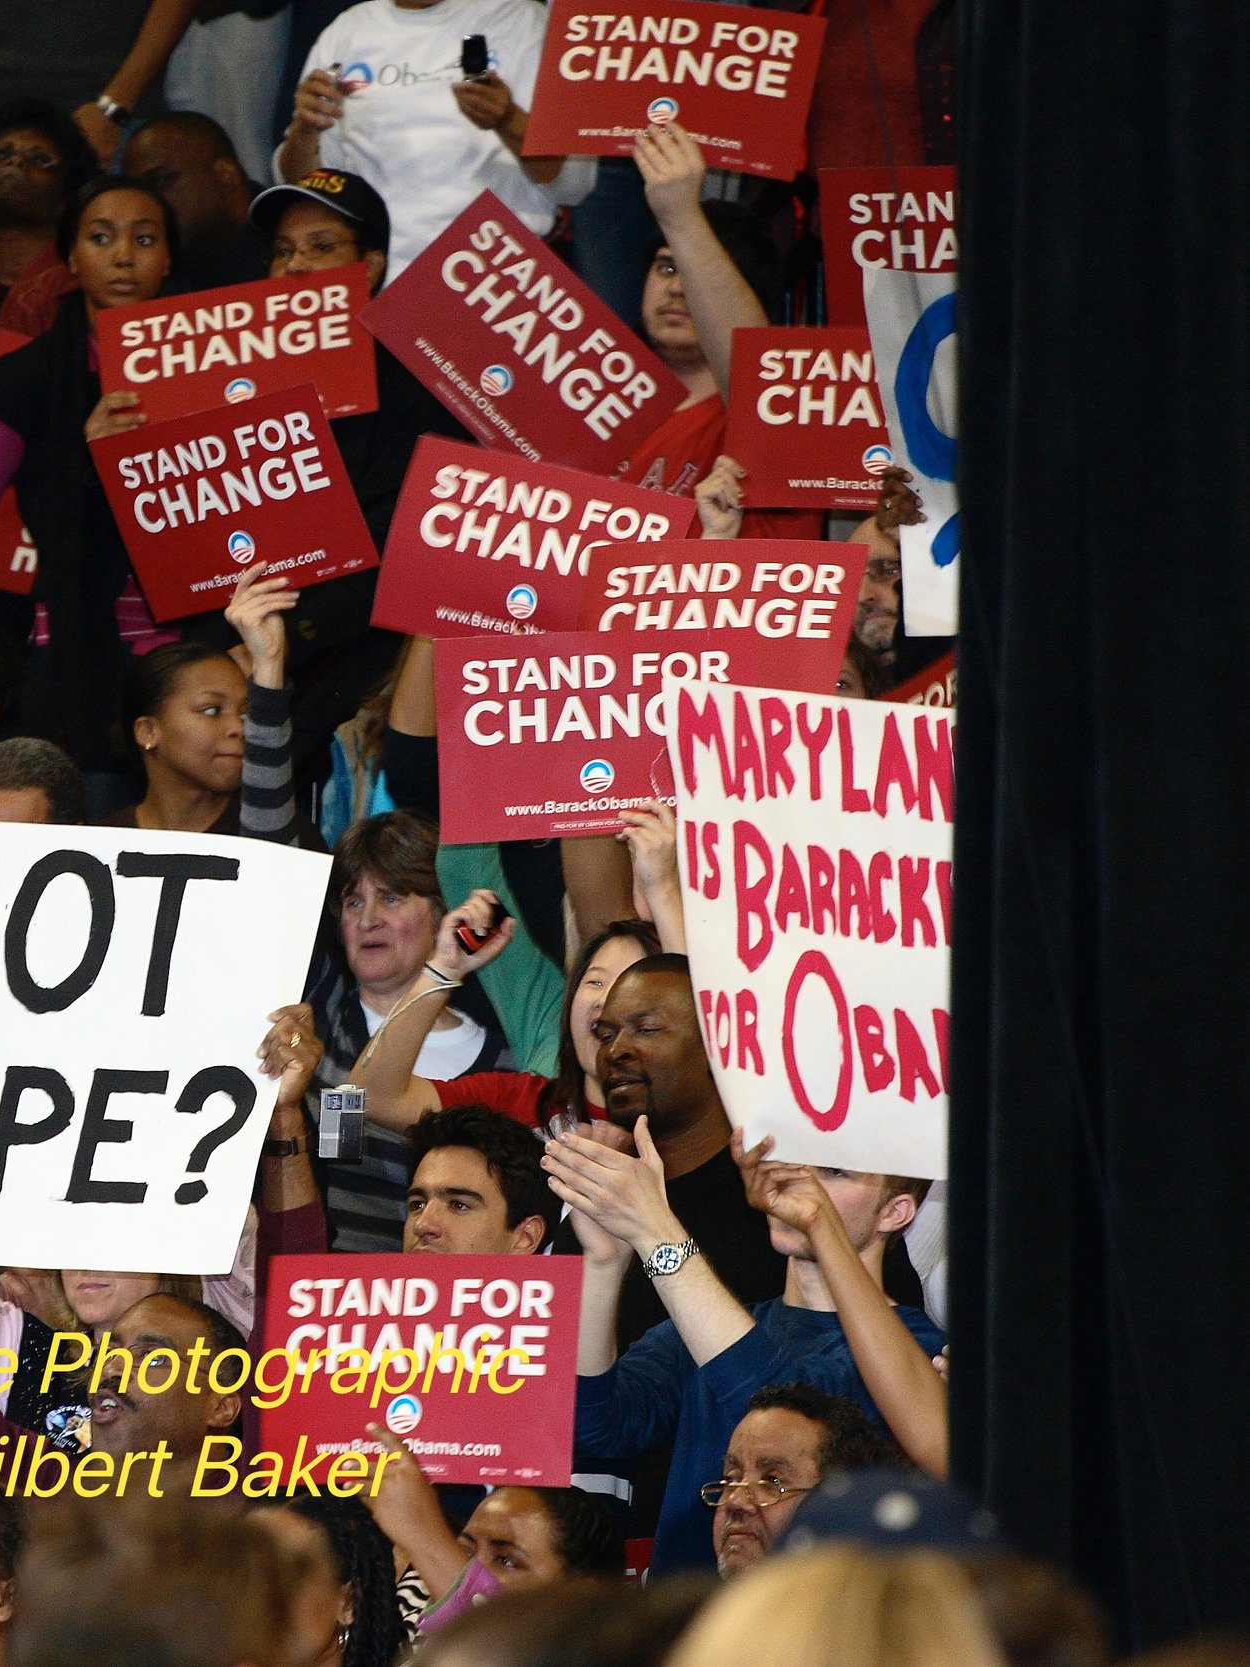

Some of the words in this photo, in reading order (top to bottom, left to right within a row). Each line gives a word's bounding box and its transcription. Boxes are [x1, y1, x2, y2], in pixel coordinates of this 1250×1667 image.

[565, 15, 700, 45] STAND
[710, 22, 798, 58] FOR
[558, 45, 792, 98] CHANGE
[849, 191, 955, 225] STAN
[851, 229, 959, 270] CHA
[121, 301, 254, 347] STAND
[265, 284, 350, 321] FOR
[441, 250, 632, 441] CHANGE
[469, 220, 584, 331] STAND
[579, 328, 657, 409] FOR
[123, 314, 351, 384] CHANGE
[758, 349, 877, 383] STAN
[414, 337, 541, 463] www.BarackObama.com
[757, 384, 887, 427] CHA
[118, 435, 227, 490] STAND
[233, 411, 315, 460] FOR
[133, 446, 331, 534] CHANGE
[430, 464, 571, 524] STAND
[579, 499, 670, 543] FOR
[419, 502, 612, 577] CHAN
[604, 562, 741, 599] STAND
[750, 562, 846, 595] FOR
[599, 598, 838, 640] CHANGE
[462, 654, 617, 695] STAND
[632, 650, 730, 687] FOR
[678, 686, 956, 823] MARYLAN
[684, 820, 721, 900] IS
[699, 989, 764, 1076] FOR
[782, 949, 951, 1132] OBA
[287, 1278, 439, 1317] STAND
[451, 1278, 554, 1319] FOR
[285, 1323, 550, 1376] CHANGE
